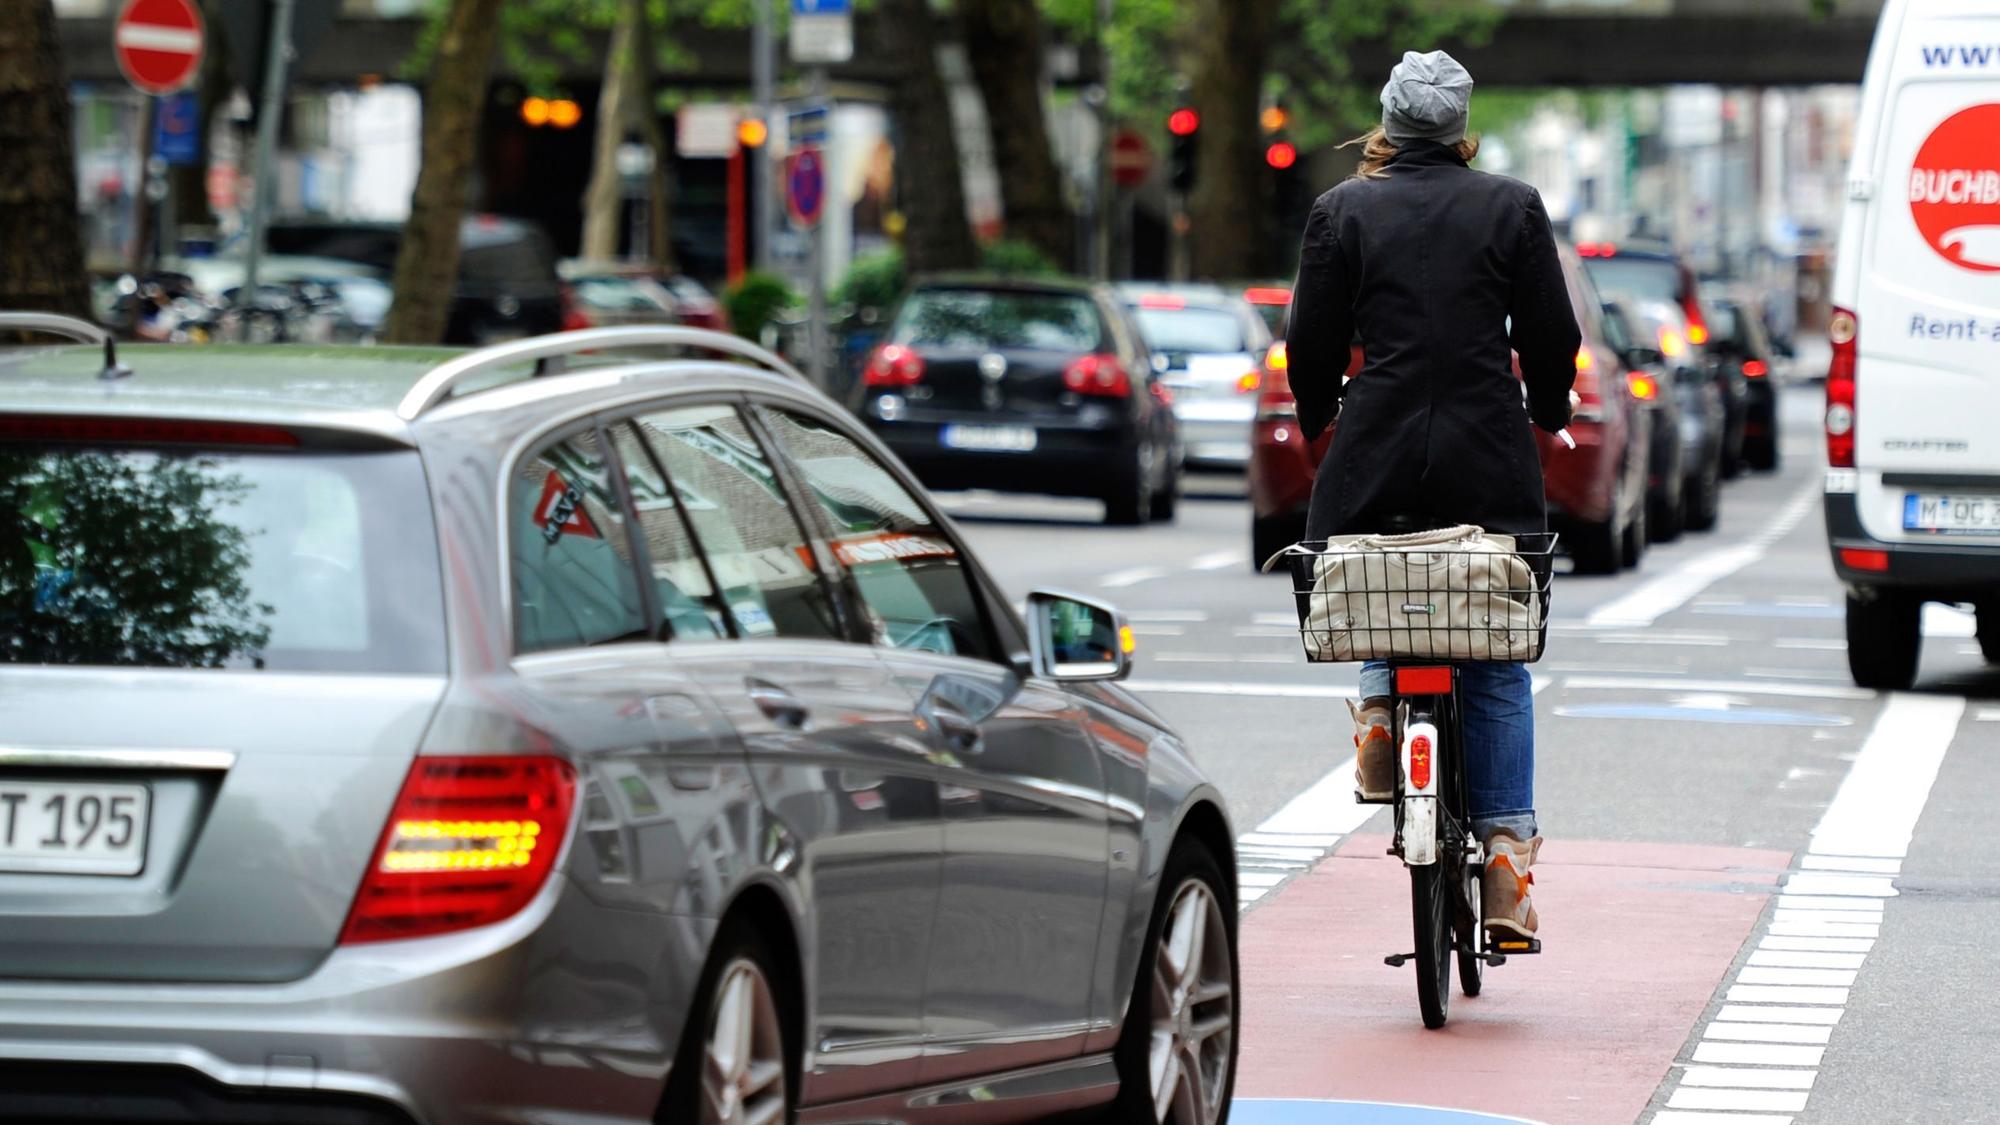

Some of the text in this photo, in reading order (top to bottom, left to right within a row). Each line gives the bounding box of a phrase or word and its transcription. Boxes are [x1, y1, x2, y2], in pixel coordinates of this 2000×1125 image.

[1922, 46, 2000, 65] ww
[1909, 167, 2000, 204] BUCHB
[40, 794, 135, 848] 195
